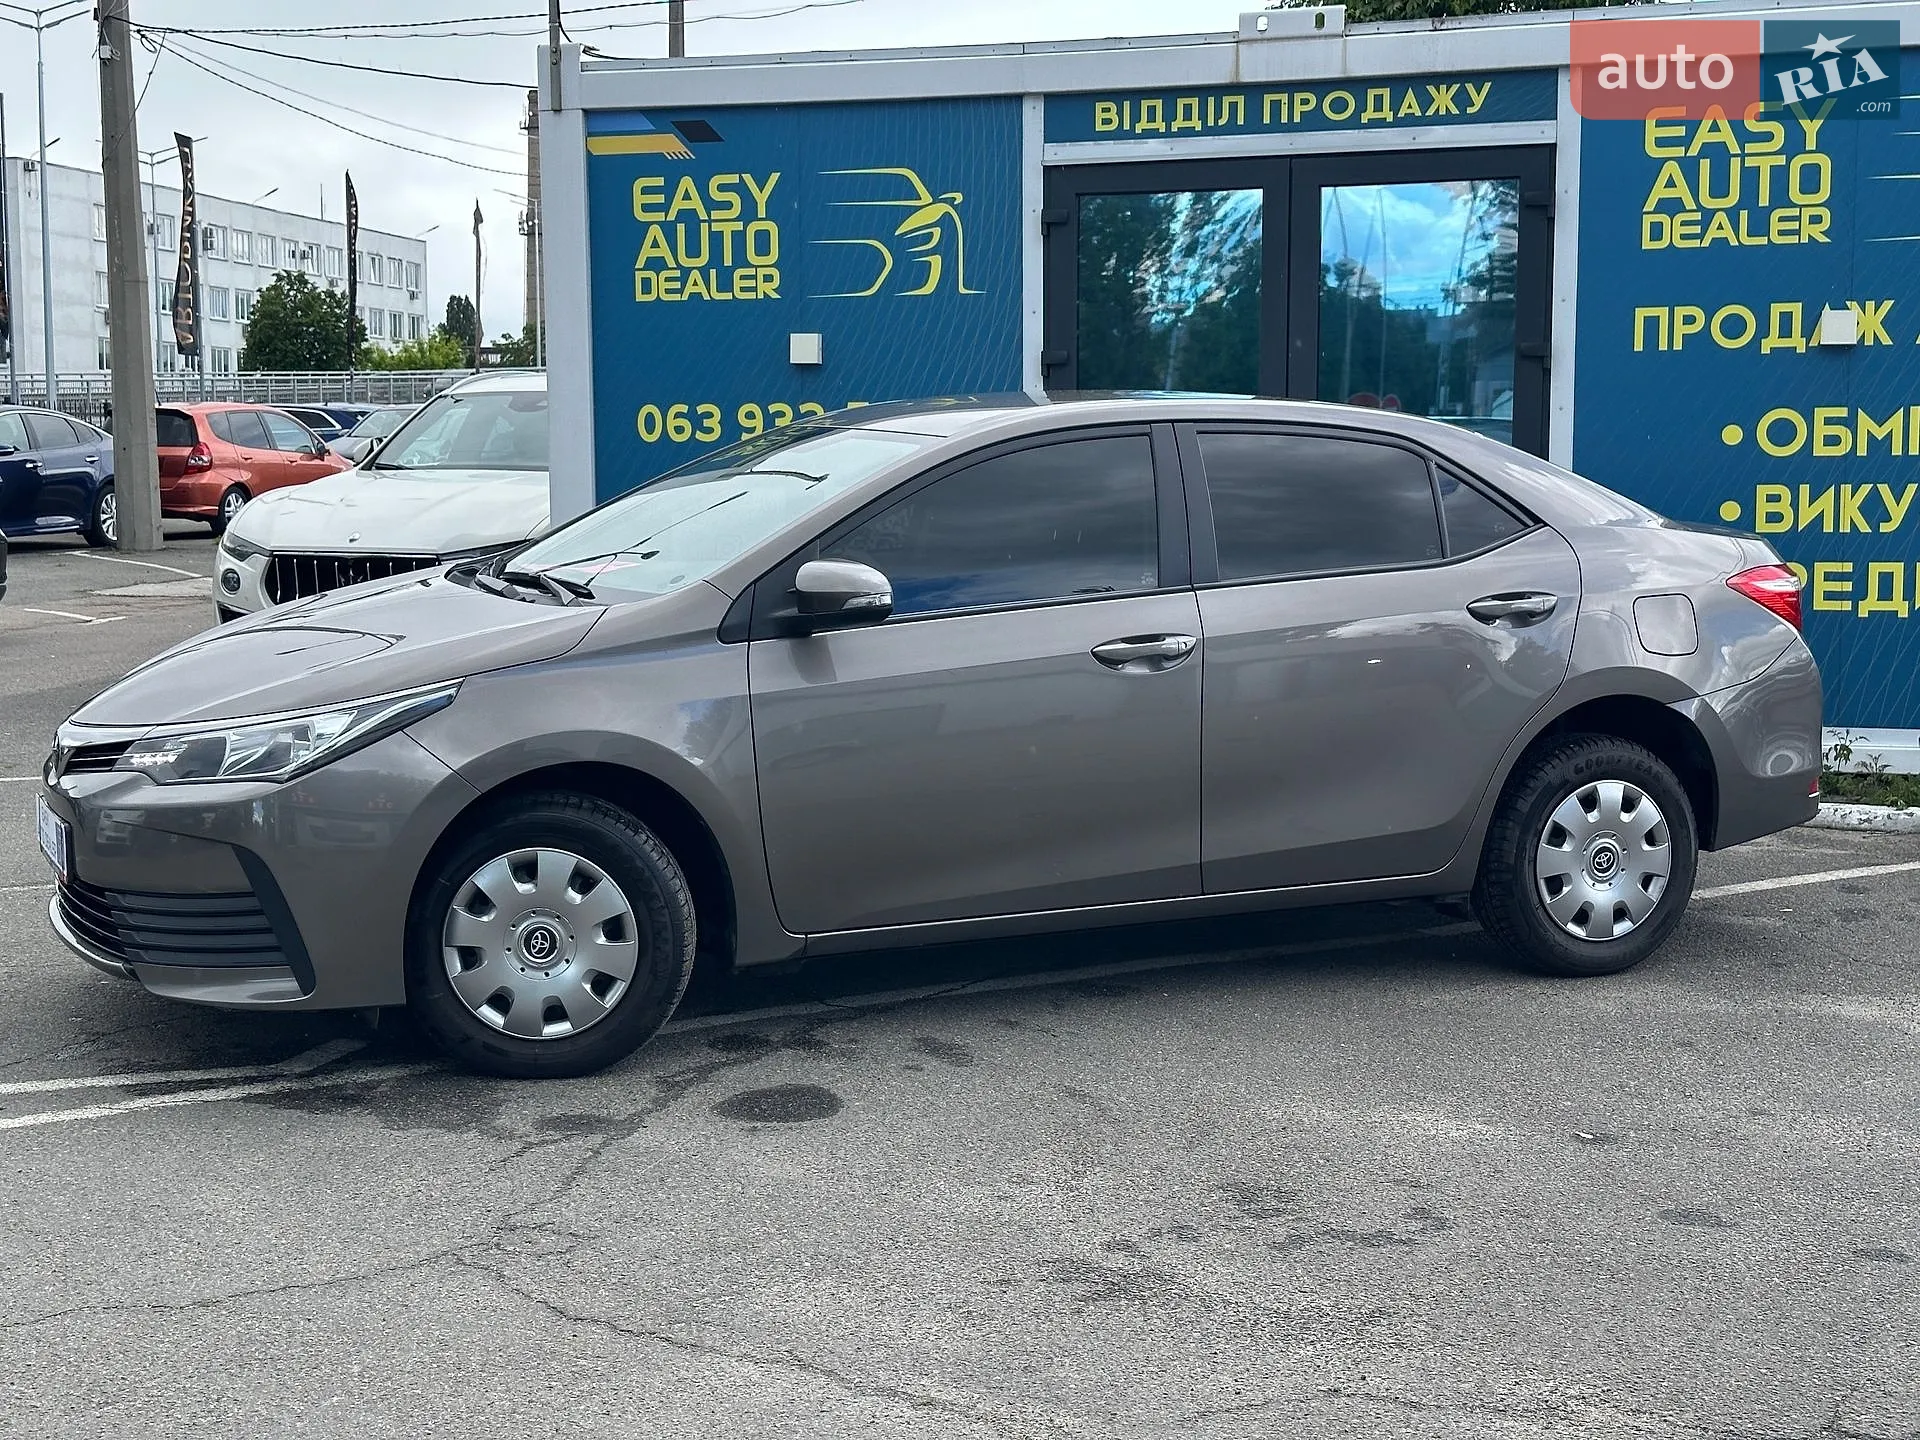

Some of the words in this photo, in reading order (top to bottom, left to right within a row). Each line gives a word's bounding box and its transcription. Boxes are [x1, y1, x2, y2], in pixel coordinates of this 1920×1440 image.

[1094, 95, 1245, 133] ВІДДІЛ
[1262, 81, 1493, 124] ПРОДАЖУ
[1643, 98, 1839, 158] EASY
[632, 172, 781, 222] EASY
[1643, 152, 1833, 212] AUTO
[635, 219, 780, 269] AUTO
[1641, 206, 1832, 250] DEALER
[634, 266, 782, 302] DEALER
[637, 402, 723, 443] 063
[1755, 483, 1919, 534] ВИКУ
[1787, 561, 1920, 618] ЕД
